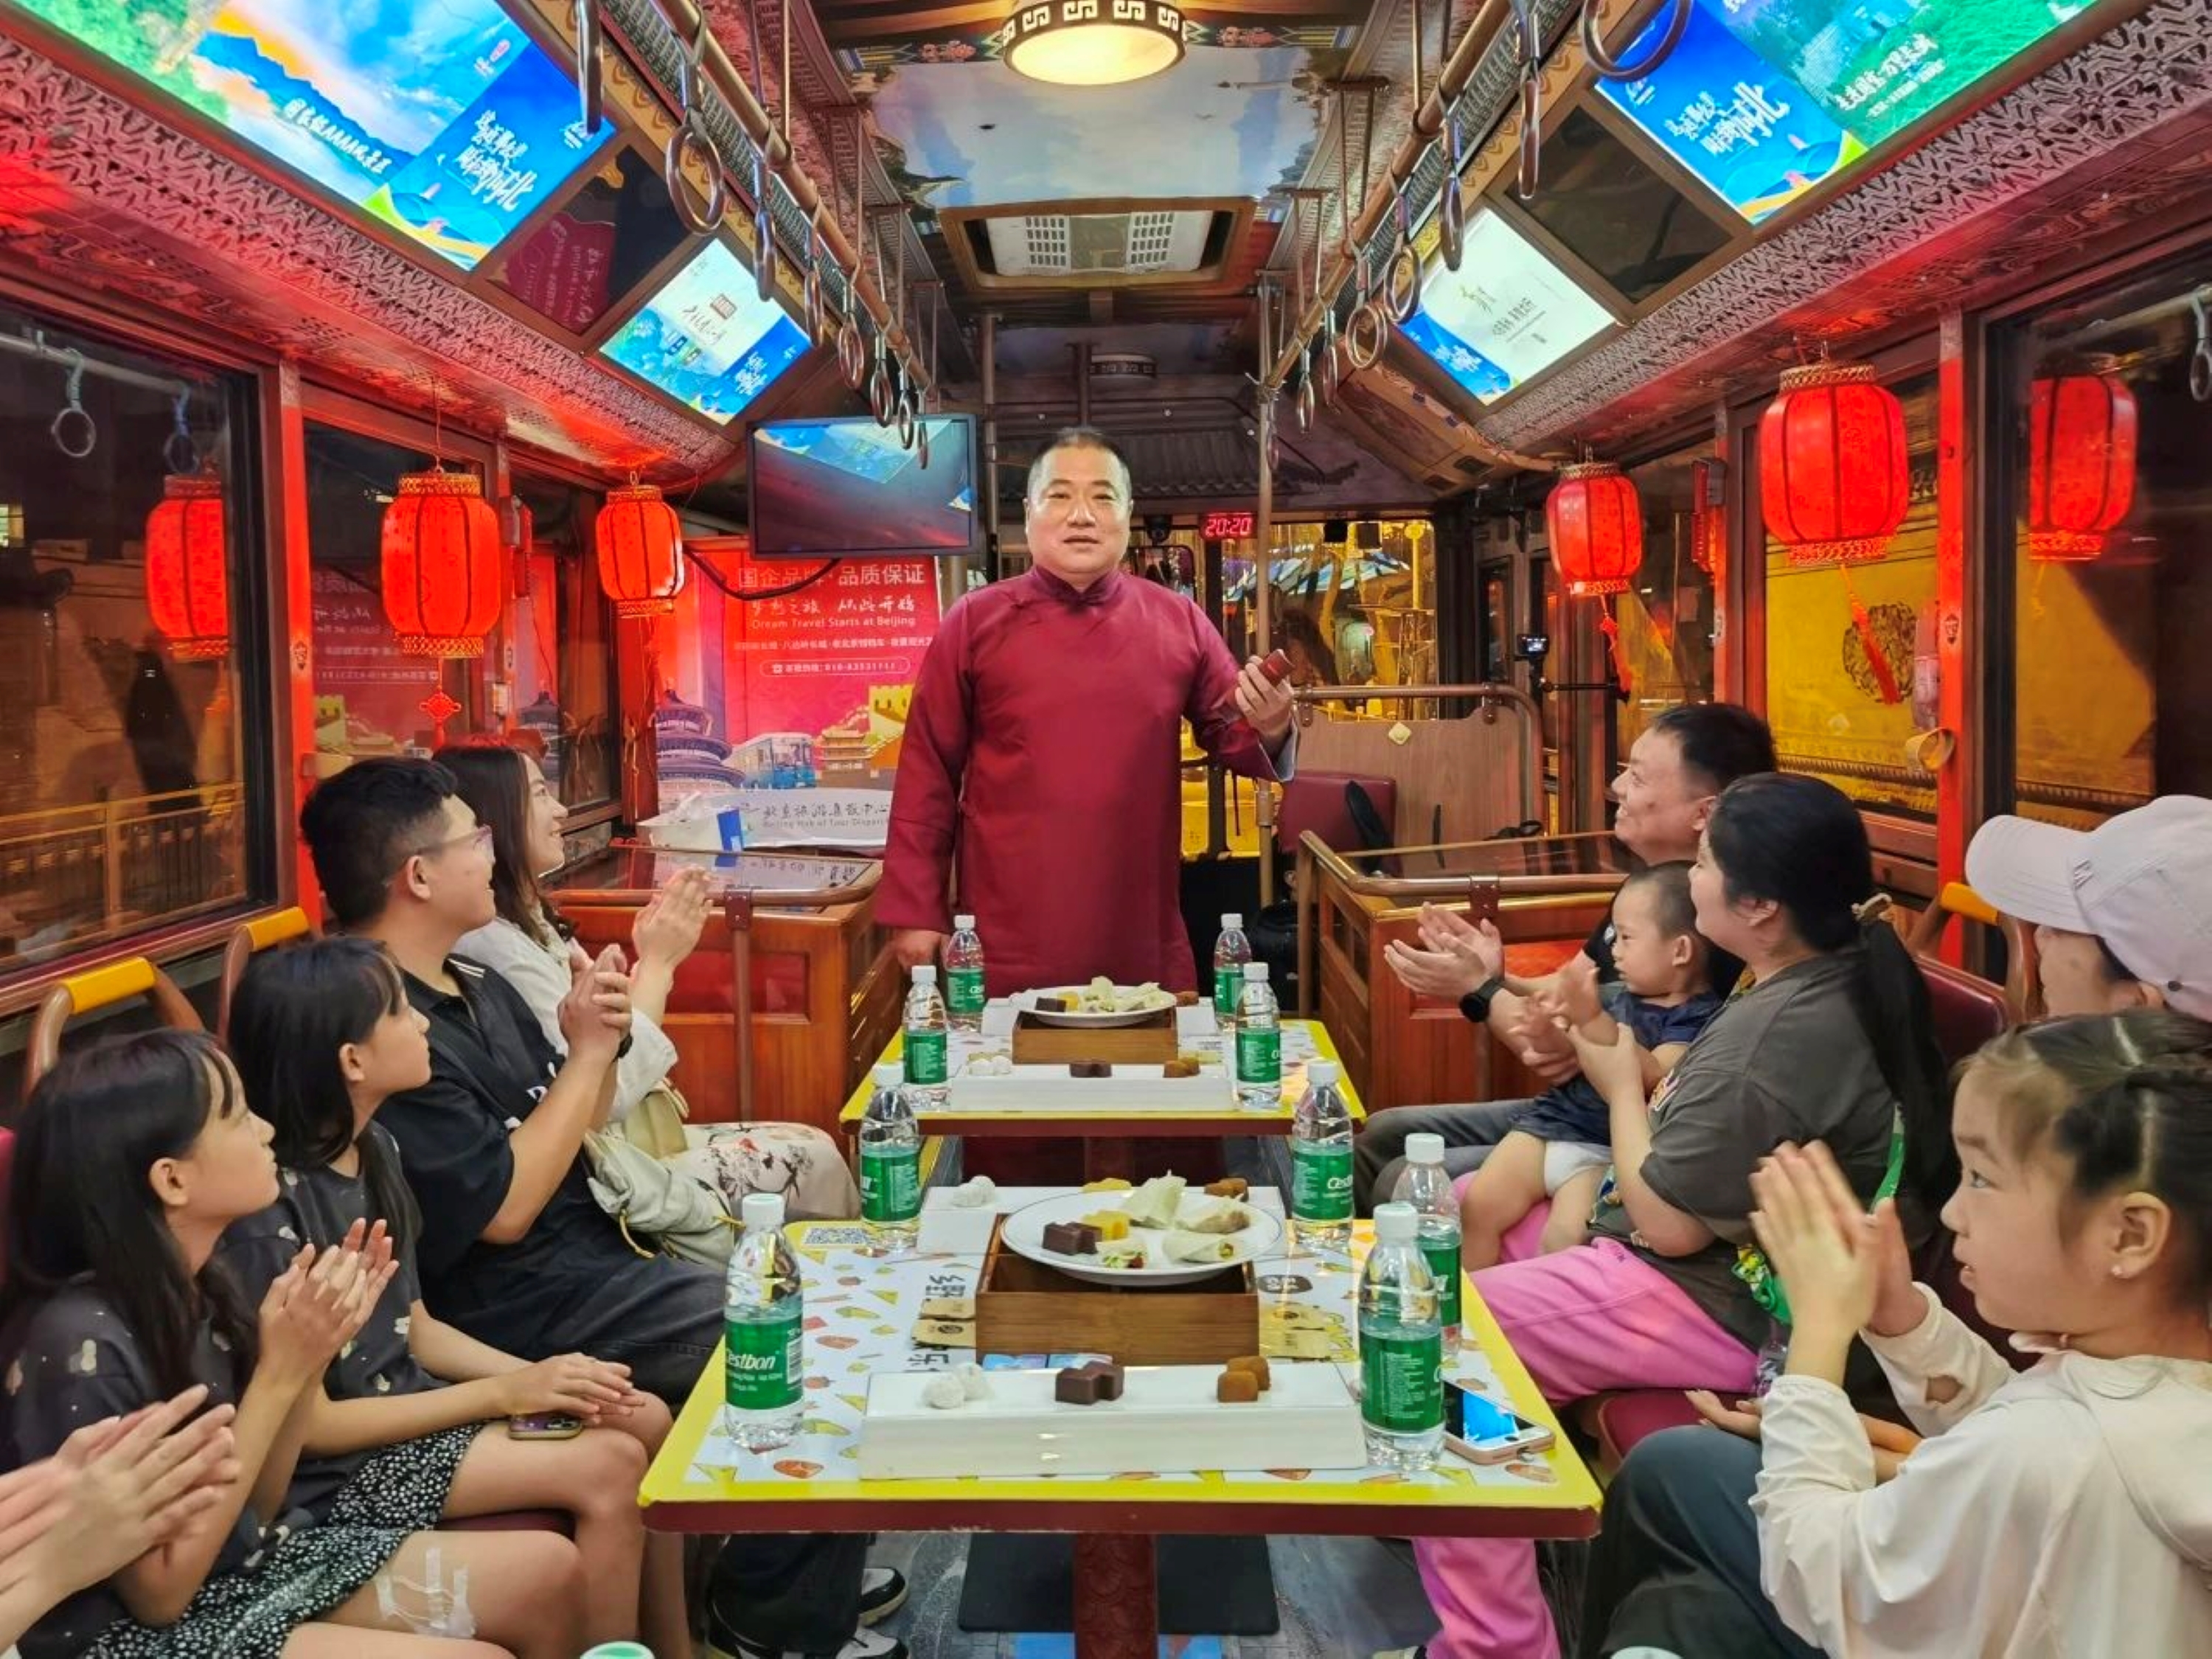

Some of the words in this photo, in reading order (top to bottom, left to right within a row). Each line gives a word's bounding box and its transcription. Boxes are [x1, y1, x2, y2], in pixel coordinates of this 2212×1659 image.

[1206, 518, 1252, 537] 20:20
[753, 619, 788, 630] Dream
[791, 619, 825, 628] Travel
[828, 617, 860, 627] Starts
[863, 618, 873, 626] at
[877, 616, 916, 627] Beijing
